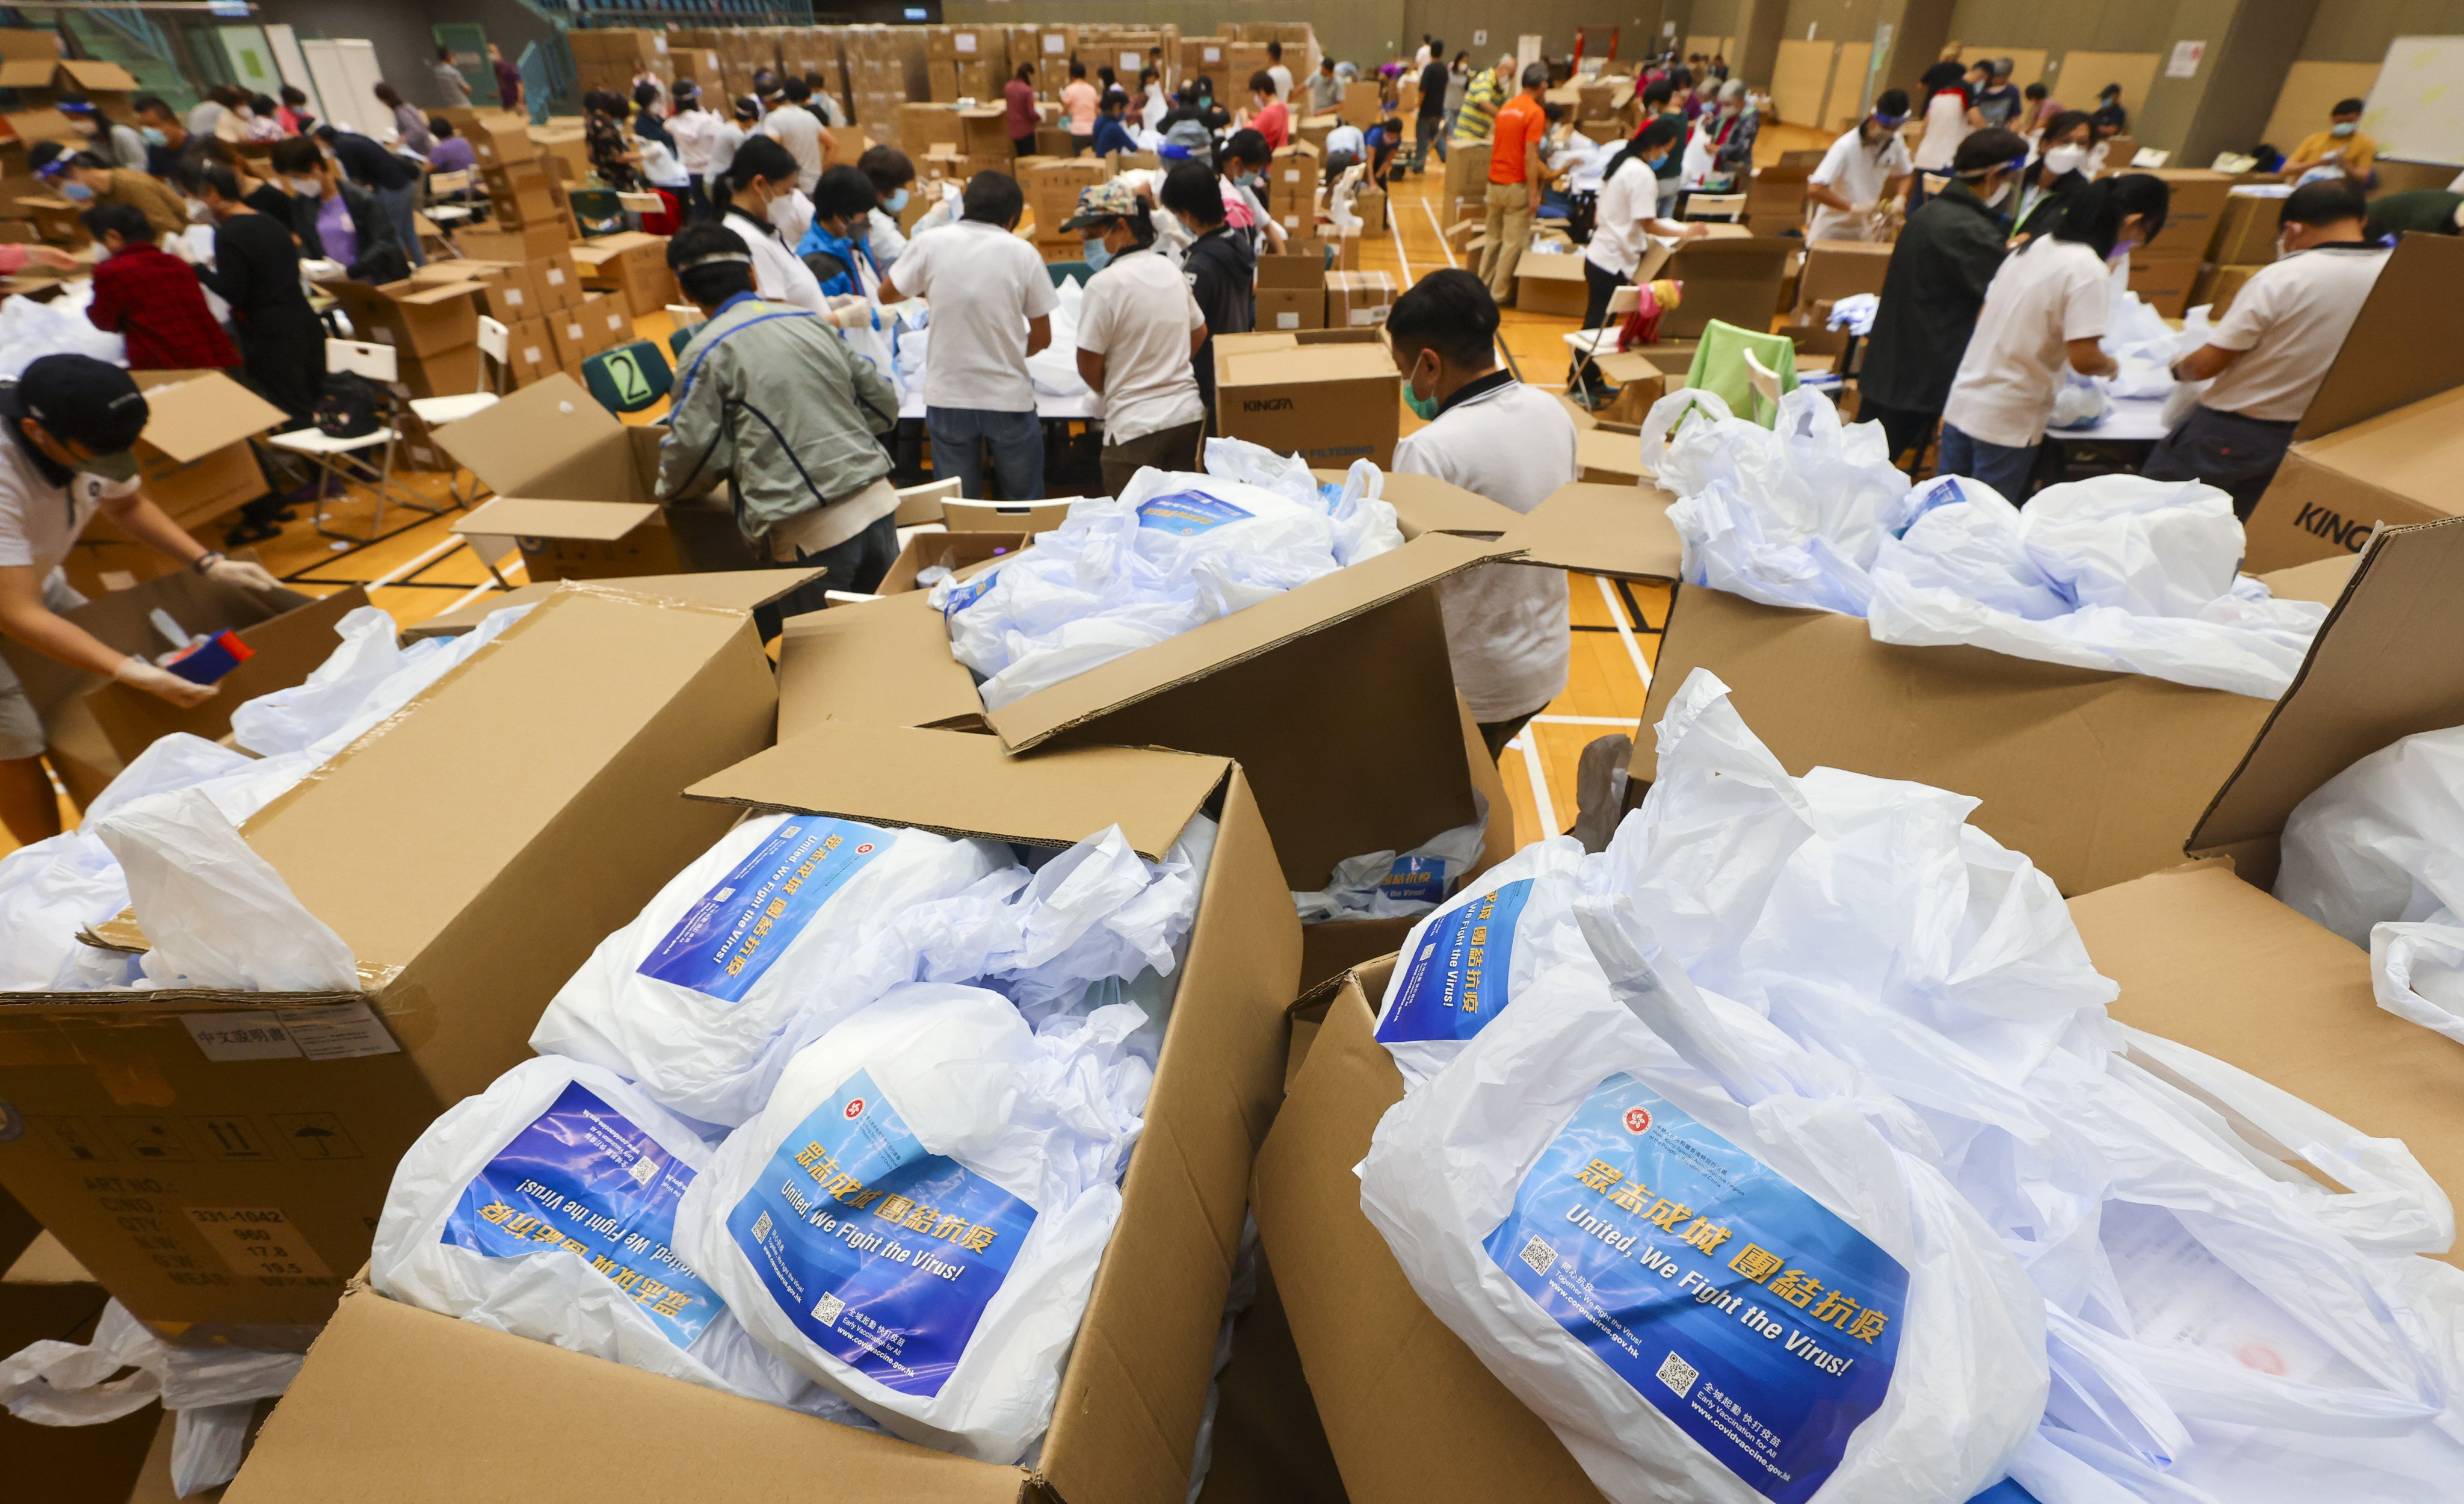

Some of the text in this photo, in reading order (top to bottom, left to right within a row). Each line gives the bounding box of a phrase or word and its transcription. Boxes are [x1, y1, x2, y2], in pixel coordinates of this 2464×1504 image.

[611, 356, 648, 400] 2
[1243, 398, 1293, 412] KINGFA
[1310, 445, 1375, 458] FILTERING
[785, 835, 818, 863] United,
[772, 865, 790, 880] We
[750, 881, 776, 909] Fight
[738, 909, 755, 928] the
[713, 930, 743, 964] Virus!
[724, 897, 787, 978] 團結抗疫
[1443, 902, 1478, 1007] We Fight the Virus!
[1461, 926, 1487, 1014] 團結抗疫
[1662, 1143, 1681, 1159] Peoples
[514, 1179, 564, 1210] Virus!
[562, 1201, 590, 1222] the
[794, 1140, 998, 1254] 眾志成城 團結抗疫
[192, 1210, 283, 1223] 331-1042
[584, 1213, 627, 1243] Fight
[781, 1178, 966, 1281] United, We Fight the Virus!
[233, 1229, 270, 1240] 960
[624, 1233, 651, 1255] We
[1574, 1158, 1889, 1345] 眾志成城 團結抗疫
[262, 1263, 302, 1273] 19.5
[1561, 1261, 1595, 1294] 同心抗疫
[1566, 1203, 1854, 1377] United, We Fight the Virus!
[1549, 1279, 1639, 1359] www.coronavirus.gov.hk
[1555, 1270, 1642, 1346] Together, We Fight the Virus!
[837, 1326, 915, 1378] www.covidvaccine.gov.hk
[842, 1317, 902, 1357] Early Vaccination for All
[1697, 1391, 1777, 1459] Early Vaccination for All
[1703, 1382, 1782, 1448] 全城起動 快打疫苗
[1691, 1400, 1791, 1482] www.covidvaccine.gov.hk
